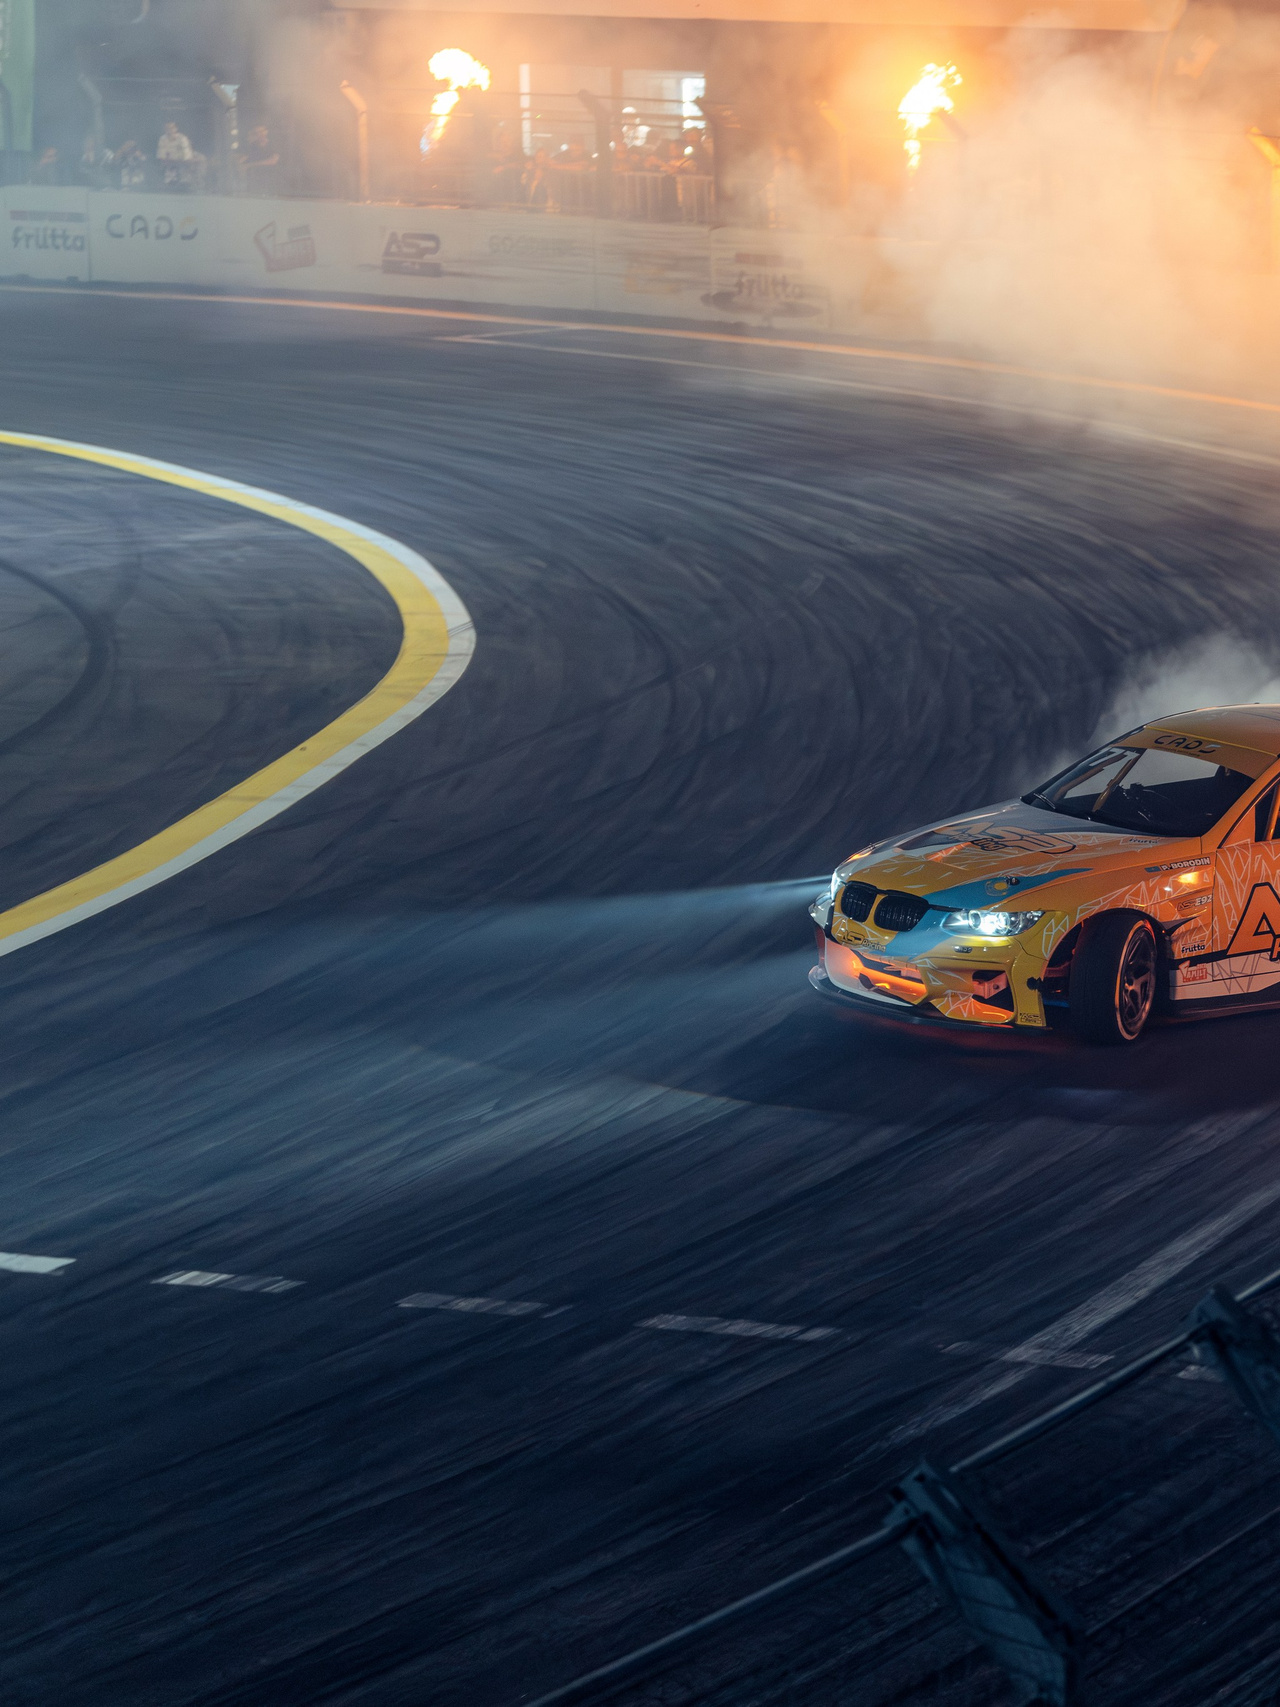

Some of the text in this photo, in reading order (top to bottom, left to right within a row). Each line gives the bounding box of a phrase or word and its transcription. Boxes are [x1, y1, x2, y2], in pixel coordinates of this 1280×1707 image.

[105, 214, 199, 240] CADS
[382, 231, 441, 259] ASP
[1154, 735, 1221, 754] CADS
[1171, 857, 1210, 869] BORODIN
